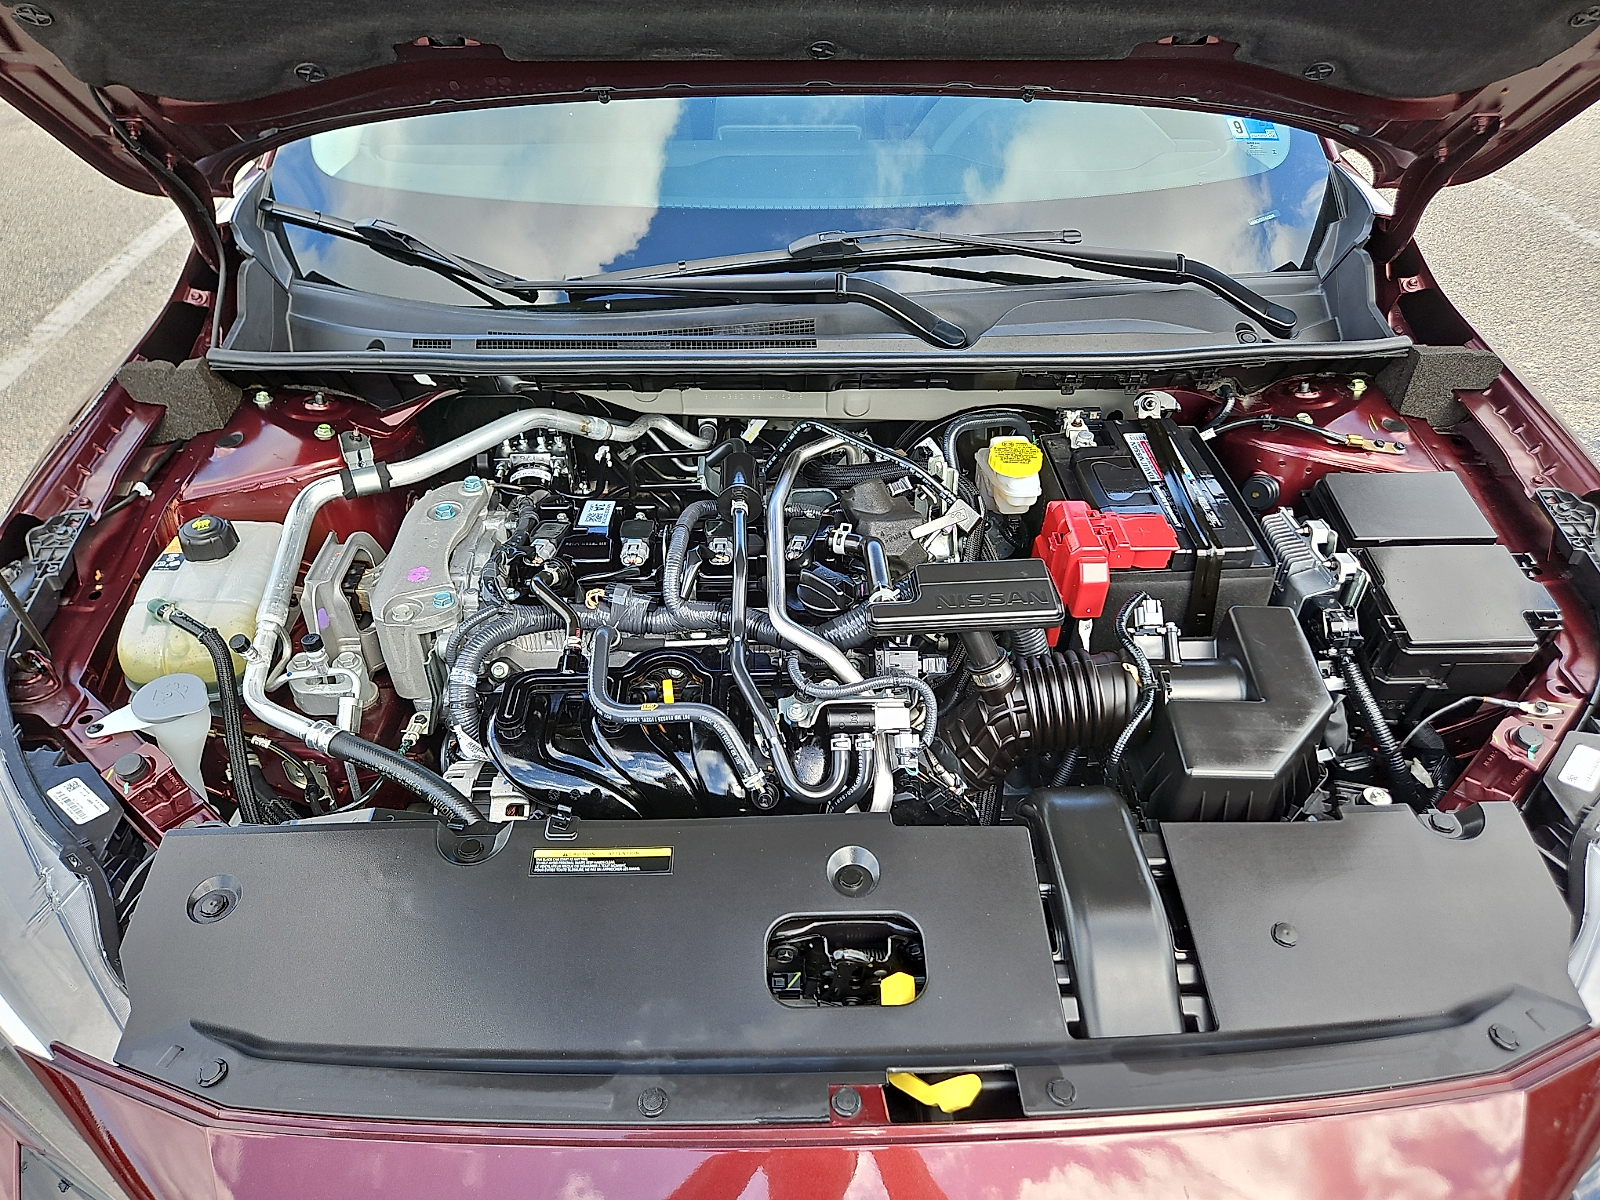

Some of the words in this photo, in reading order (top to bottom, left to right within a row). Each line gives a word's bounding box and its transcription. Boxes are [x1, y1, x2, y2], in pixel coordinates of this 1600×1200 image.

[1233, 120, 1243, 134] 9
[936, 590, 1050, 610] NISSAN
[427, 794, 456, 820] NICHIRIN
